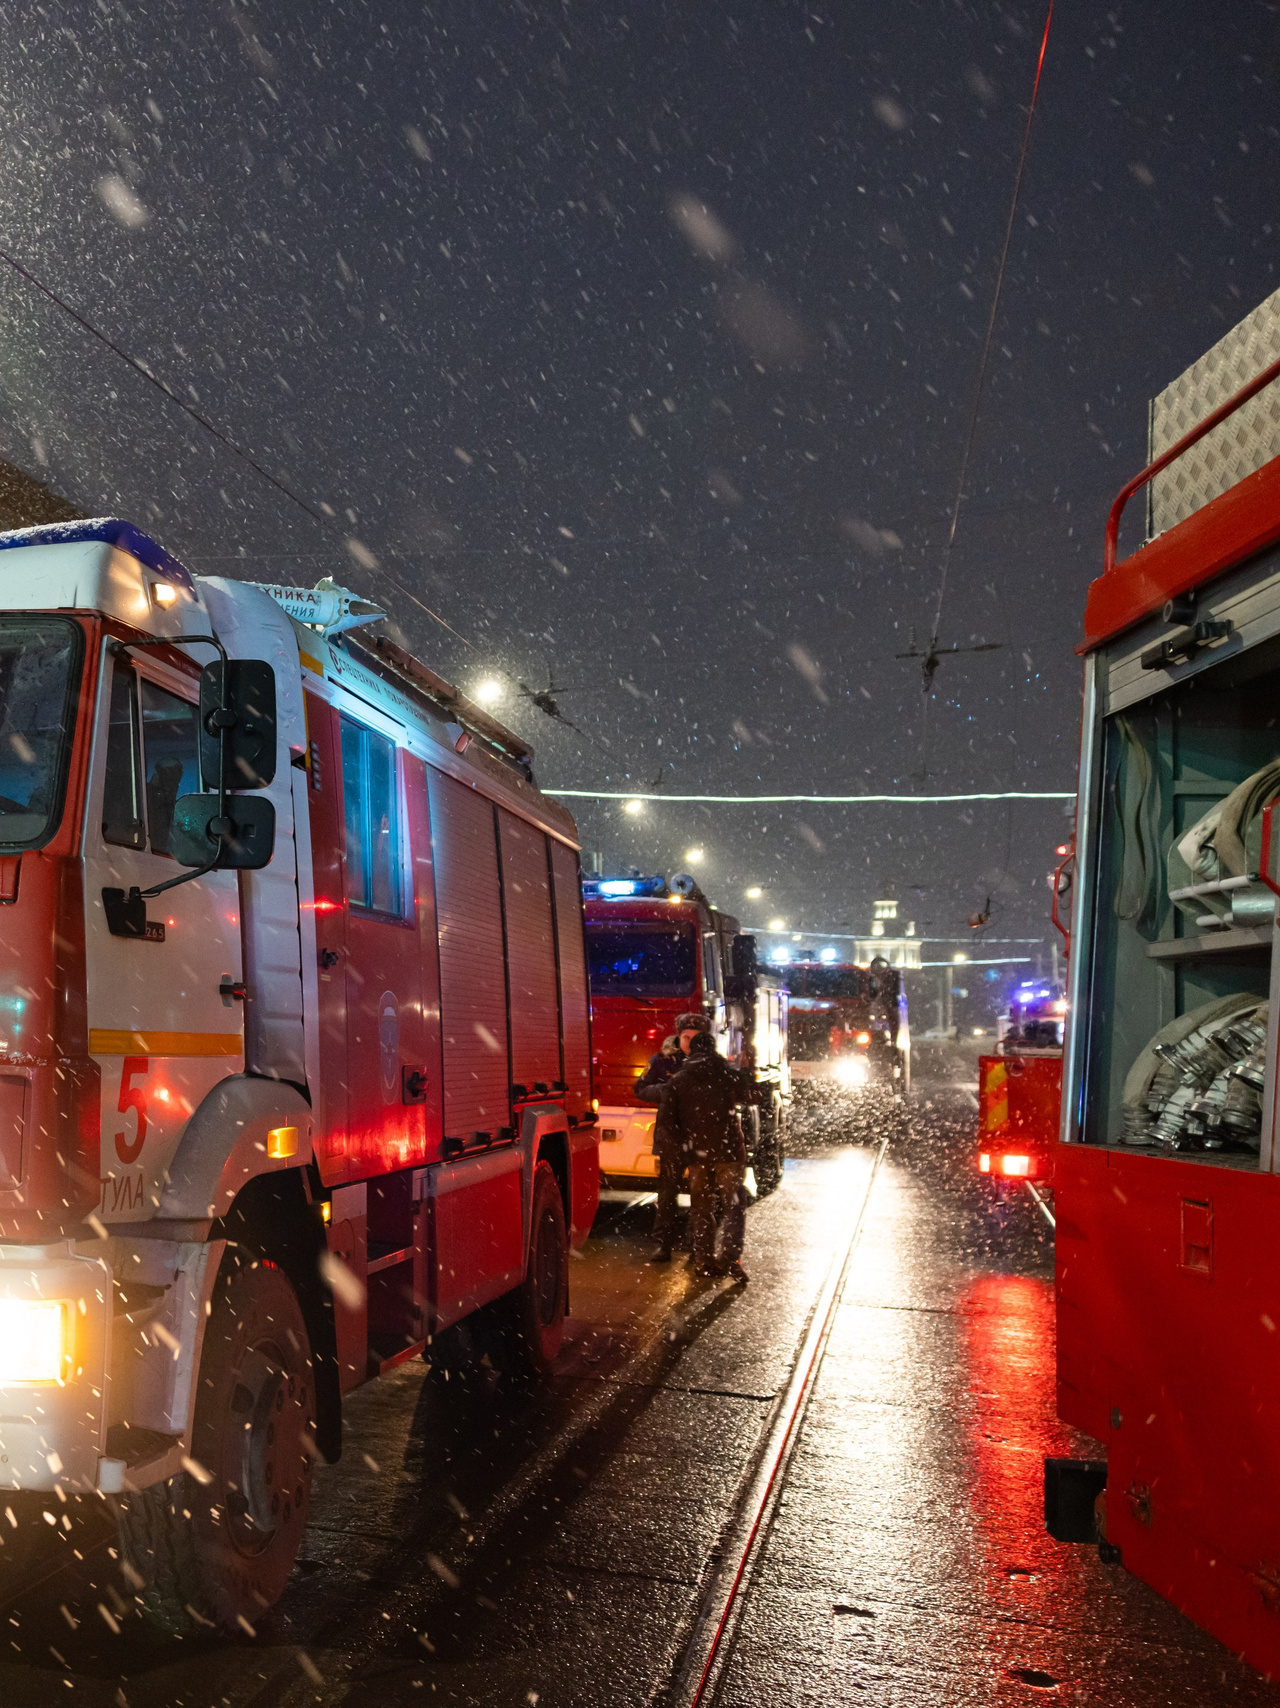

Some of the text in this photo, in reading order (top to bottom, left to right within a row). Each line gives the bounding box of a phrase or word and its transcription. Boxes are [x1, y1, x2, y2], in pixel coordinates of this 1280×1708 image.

[263, 588, 317, 603] ХНИКА
[281, 604, 315, 618] ЕНИЯ
[145, 927, 164, 939] 265
[114, 1056, 149, 1165] 5
[100, 1173, 145, 1214] ТУЛА
